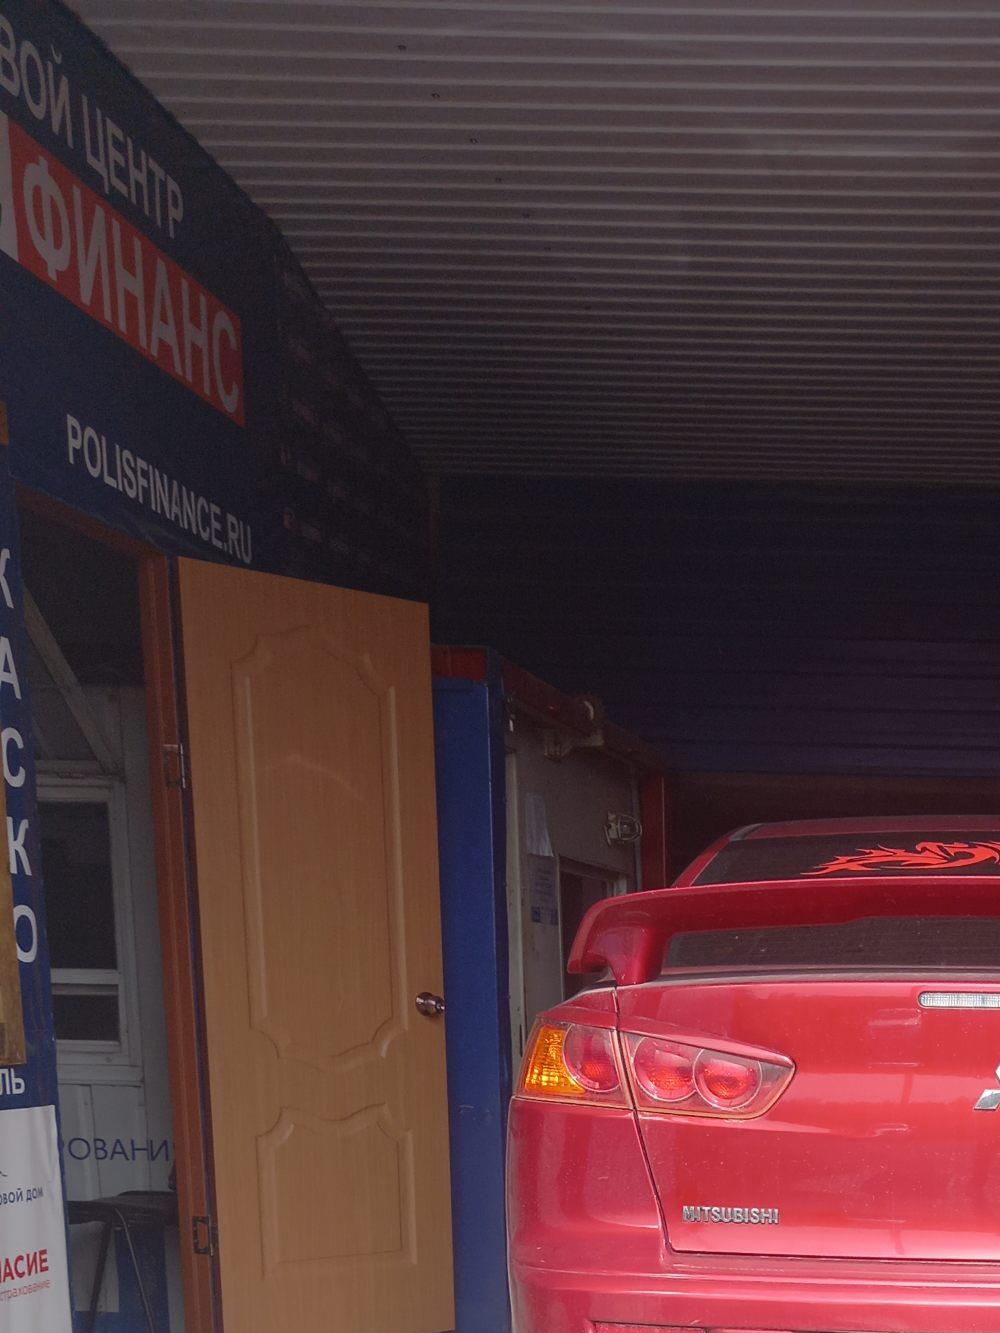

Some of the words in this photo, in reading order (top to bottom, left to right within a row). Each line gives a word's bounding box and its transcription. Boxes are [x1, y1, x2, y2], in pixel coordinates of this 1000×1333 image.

[82, 94, 184, 239] ЦЕНТР
[22, 156, 240, 414] ФИНАНС
[66, 412, 253, 565] POLISFINANCE.RU
[26, 1186, 44, 1203] ДОМ
[682, 1205, 780, 1225] MITSUBISHI
[0, 1248, 49, 1284] АСИЕ
